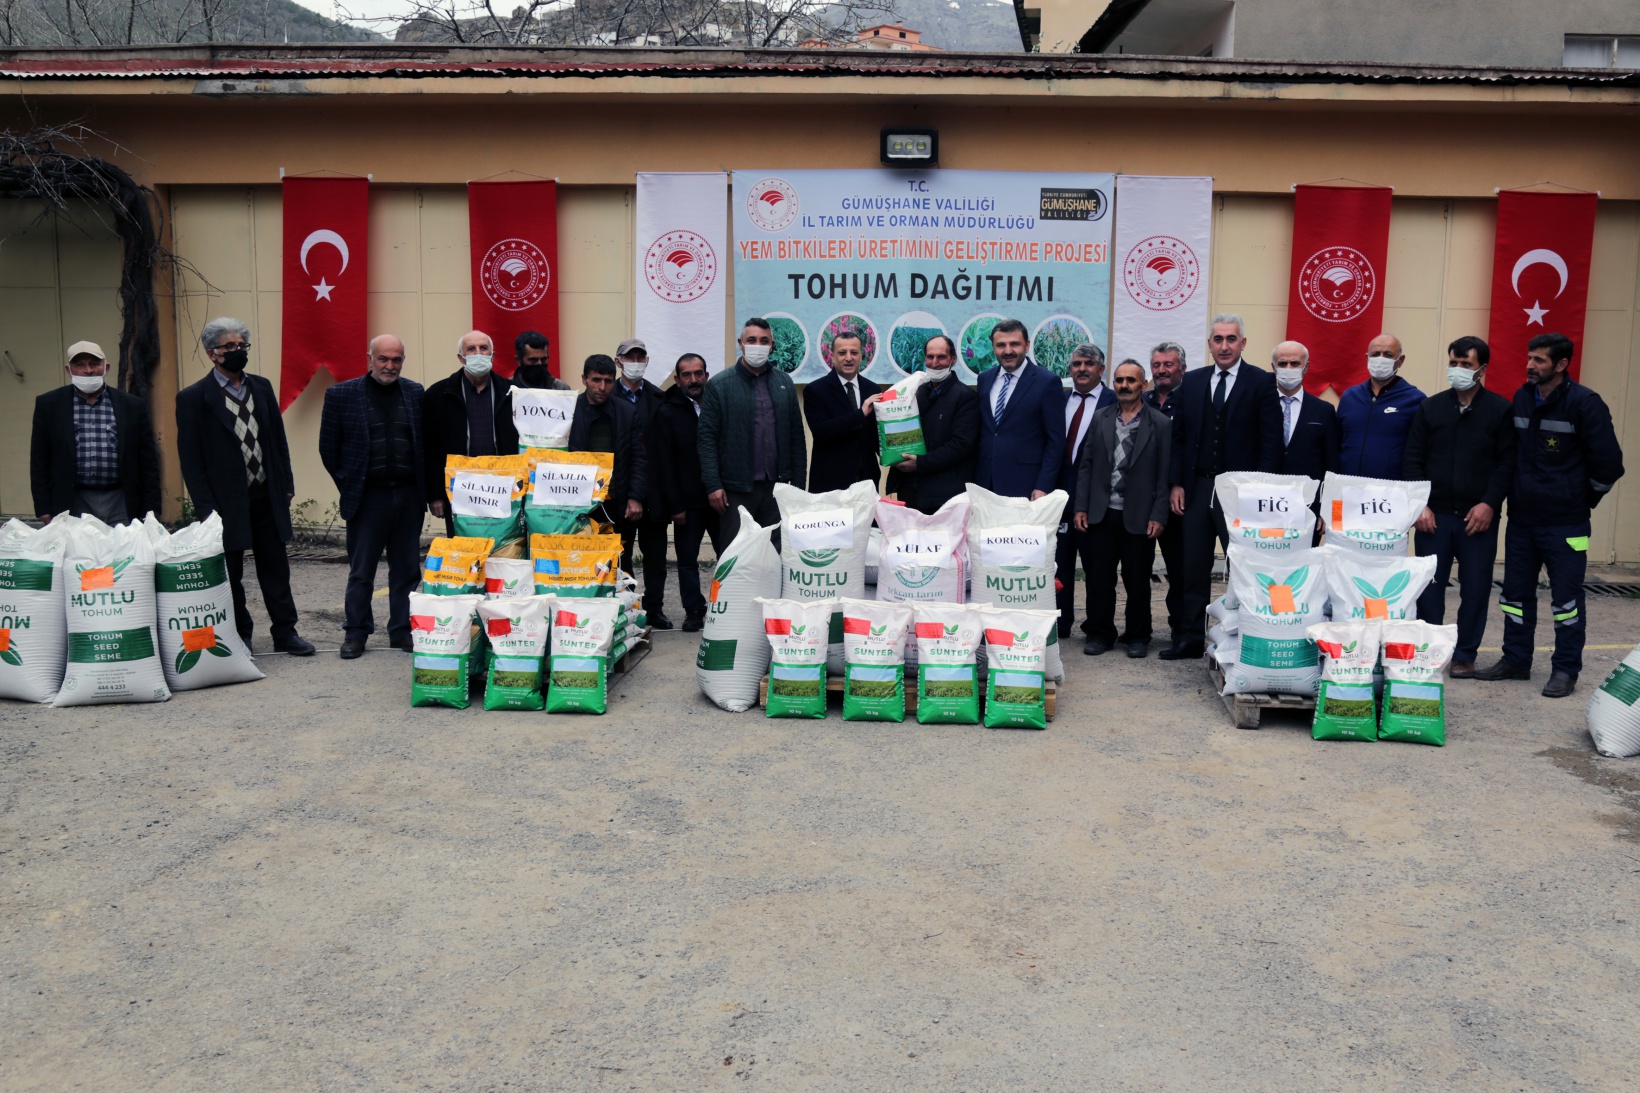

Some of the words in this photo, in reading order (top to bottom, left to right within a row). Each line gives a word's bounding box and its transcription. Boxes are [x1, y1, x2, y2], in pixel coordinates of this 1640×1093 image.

[908, 180, 930, 193] T.C.
[842, 196, 931, 214] GÜMÜŞHANE
[935, 196, 995, 212] VALİLİĞİ
[1041, 198, 1096, 212] GÜMÜŞHANE
[802, 213, 816, 228] İL
[818, 214, 862, 228] TARIM
[866, 214, 886, 228] VE
[888, 214, 940, 228] ORMAN
[944, 214, 1036, 230] MÜDÜRLÜĞÜ
[740, 240, 774, 260] YEM
[778, 235, 853, 260] BİTKİLERİ
[857, 234, 940, 260] ÜRETİMİNİ
[944, 236, 1040, 264] GELİŞTİRME
[1044, 240, 1108, 264] PROJESİ
[788, 272, 898, 300] TOHUM
[910, 267, 1054, 301] DAĞITIMI
[522, 406, 566, 420] YONCA
[542, 470, 588, 481] SİLAJLIK
[461, 481, 508, 494] SİLAJLIK
[550, 486, 579, 495] MISIR
[468, 496, 498, 507] MISIR
[1258, 496, 1289, 513] FİĞ
[1360, 498, 1392, 515] FİĞ
[794, 520, 846, 530] KORUNGA
[987, 536, 1040, 546] KORUNGA
[1359, 542, 1394, 550] TOHUM
[896, 544, 942, 553] YULAF
[176, 563, 201, 571] SEME
[179, 572, 203, 580] SEED
[790, 568, 847, 586] MUTLU
[176, 580, 210, 590] TOHUM
[987, 575, 1046, 591] MUTLU
[799, 588, 836, 597] TOHUM
[71, 590, 134, 607] MUTLU
[999, 594, 1037, 603] TOHUM
[82, 608, 122, 617] TOHUM
[178, 603, 216, 614] TOHUM
[168, 609, 227, 630] MUTLU
[419, 637, 455, 646] SUNTER
[560, 640, 597, 649] SUNTER
[854, 648, 893, 656] SUNTER
[1000, 654, 1040, 662] SUNTER
